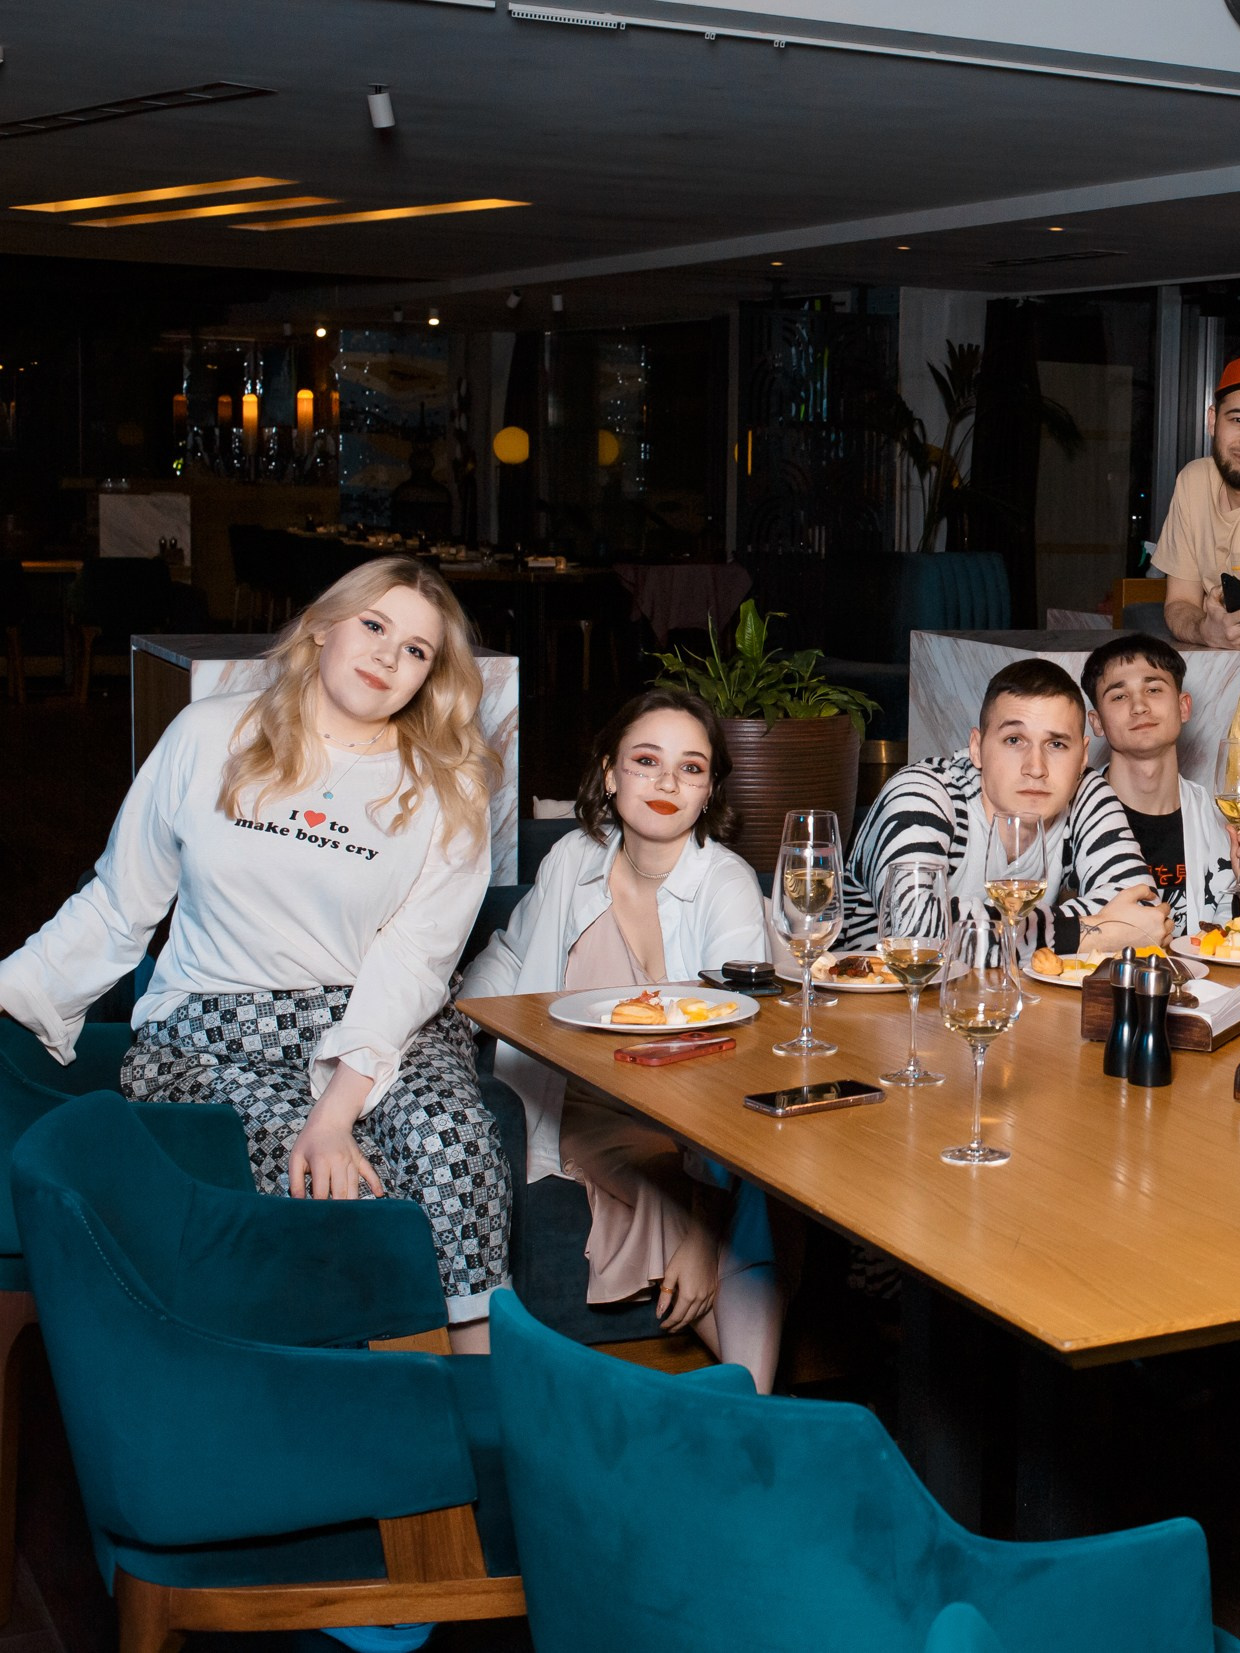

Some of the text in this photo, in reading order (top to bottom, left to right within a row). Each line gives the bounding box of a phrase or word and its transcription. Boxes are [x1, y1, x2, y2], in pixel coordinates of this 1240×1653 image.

[289, 809, 349, 834] I to
[234, 818, 379, 861] make boys cry
